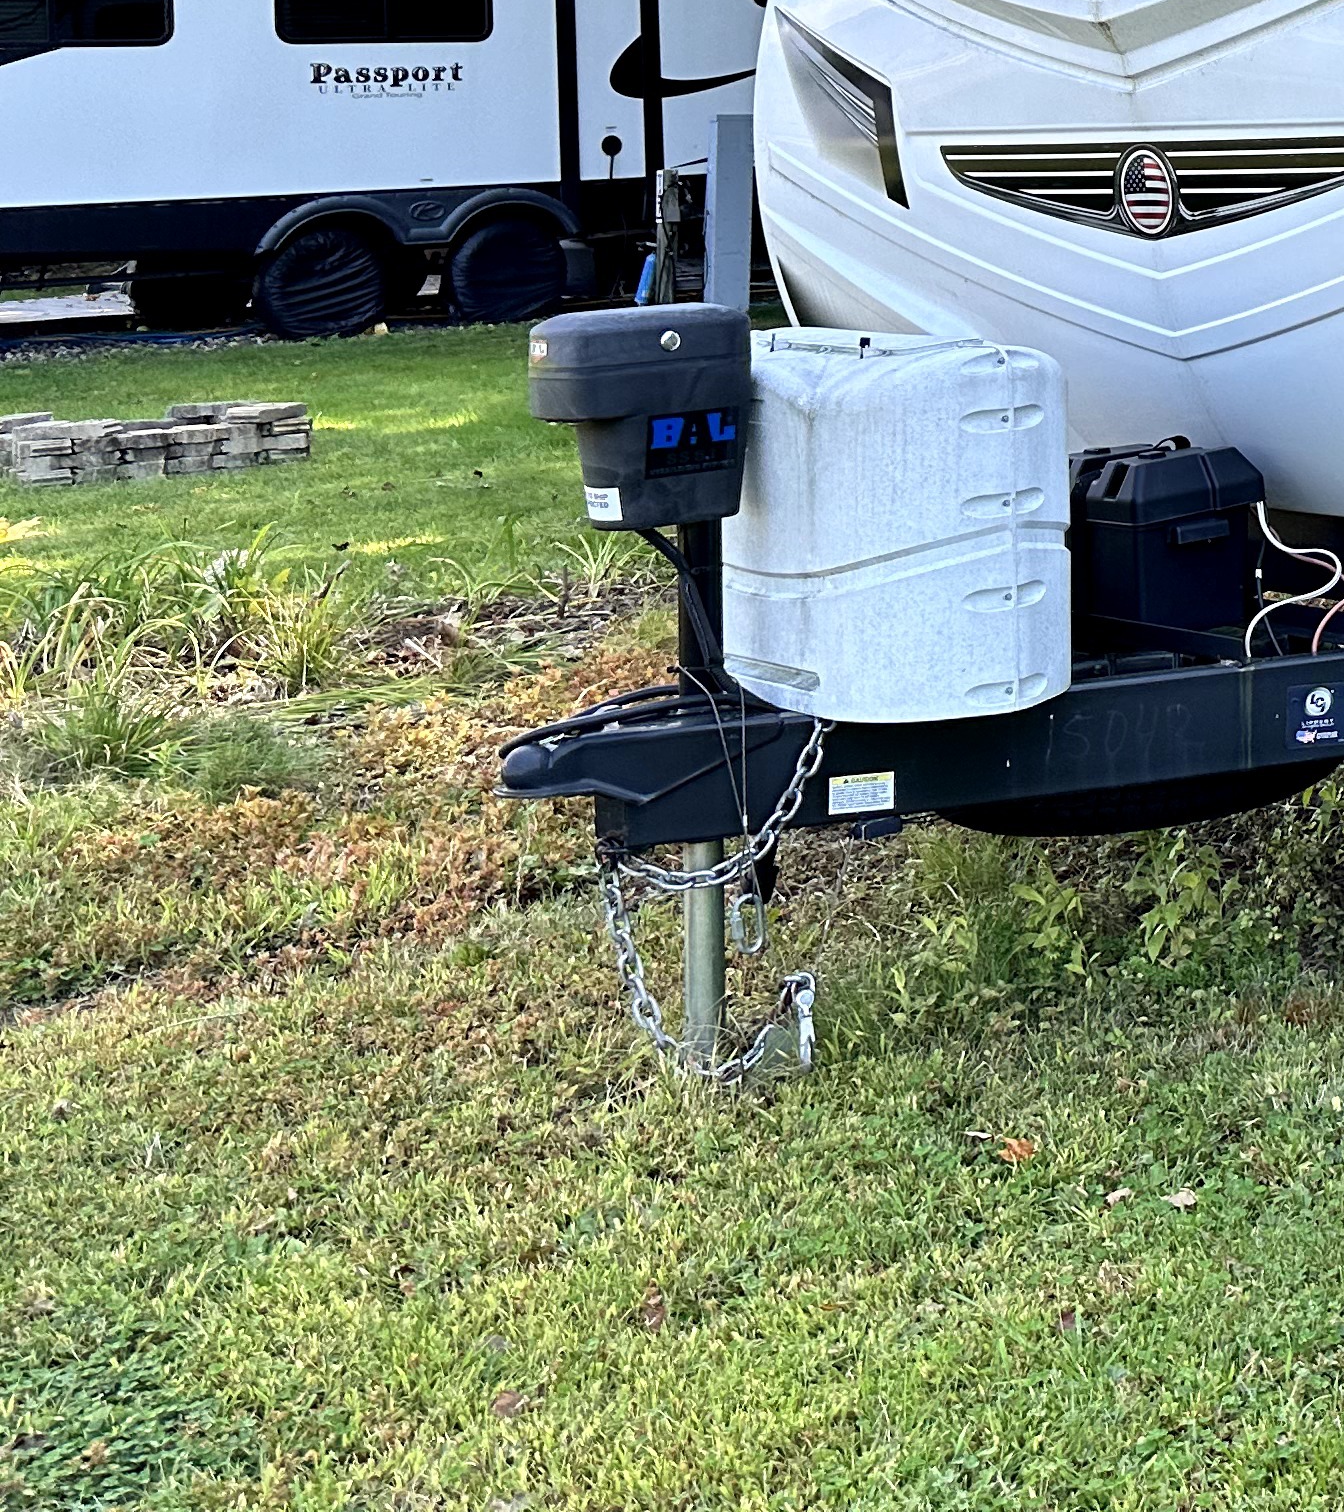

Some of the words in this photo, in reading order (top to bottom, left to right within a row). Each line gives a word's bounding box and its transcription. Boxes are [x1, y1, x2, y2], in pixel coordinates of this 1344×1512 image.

[310, 62, 464, 87] Passport
[318, 84, 387, 95] ULTRA
[408, 81, 456, 92] LITE
[651, 412, 736, 450] BAL
